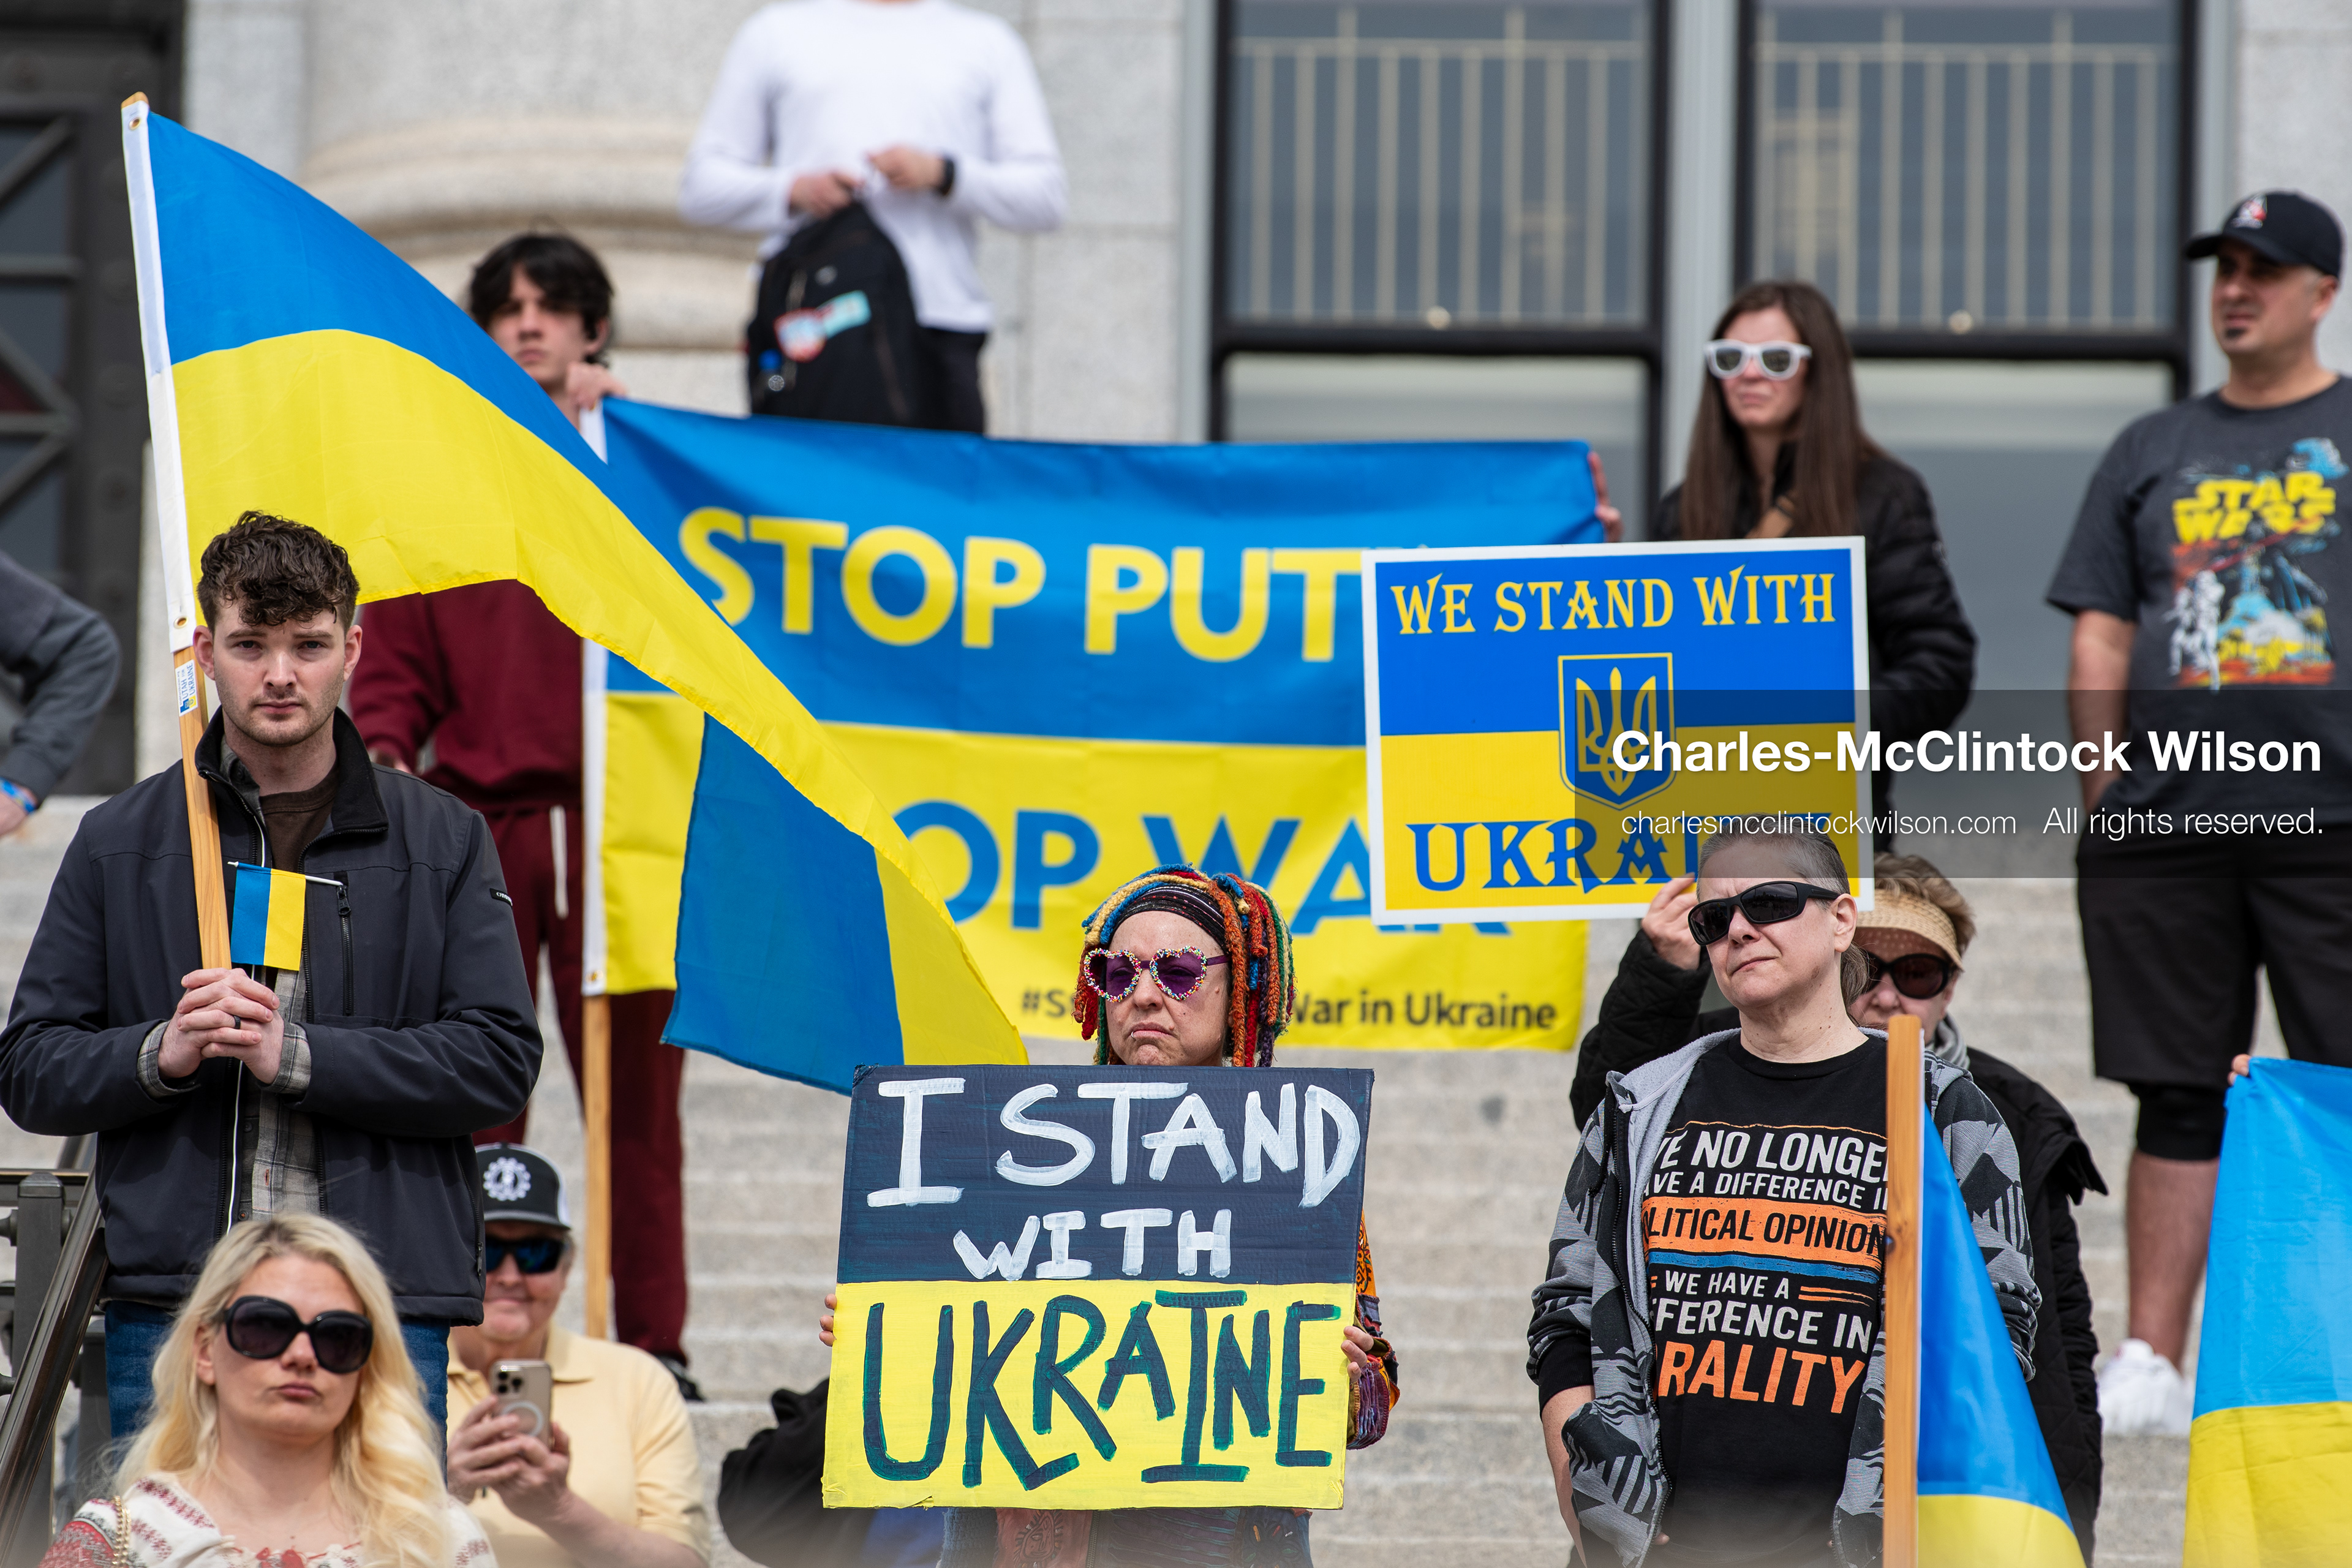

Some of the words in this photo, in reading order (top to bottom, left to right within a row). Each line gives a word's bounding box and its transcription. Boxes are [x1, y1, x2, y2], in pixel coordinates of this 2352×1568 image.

[2173, 471, 2335, 510] STAR
[2173, 502, 2335, 544] WARS
[679, 507, 1046, 647] STOP
[1084, 544, 1428, 662] PUT
[1390, 573, 1476, 635] WE
[1494, 578, 1674, 633] STAND
[1693, 564, 1836, 626] WITH
[186, 662, 195, 696] UKRAINE
[892, 799, 1102, 932] OP
[1140, 813, 1510, 936] WA
[1406, 813, 1832, 894] UKRAI
[1362, 990, 1394, 1024] in
[1407, 992, 1557, 1029] Ukraine
[867, 1078, 965, 1207] I
[995, 1082, 1360, 1207] STAND
[1691, 1130, 1751, 1169] NO
[1756, 1133, 1888, 1183] LONGE
[1689, 1171, 1705, 1194] A
[1714, 1172, 1866, 1209] DIFFERENCE
[953, 1209, 1232, 1281] WITH
[1642, 1207, 1754, 1244] OLITICAL
[1665, 1270, 1701, 1295] WE
[1707, 1272, 1768, 1297] HAVE
[1774, 1277, 1789, 1299] A
[1652, 1298, 1823, 1345] FERENCE
[1833, 1313, 1872, 1354] IN
[864, 1291, 1341, 1491] UKRAINE
[1655, 1340, 1866, 1414] RALITY
